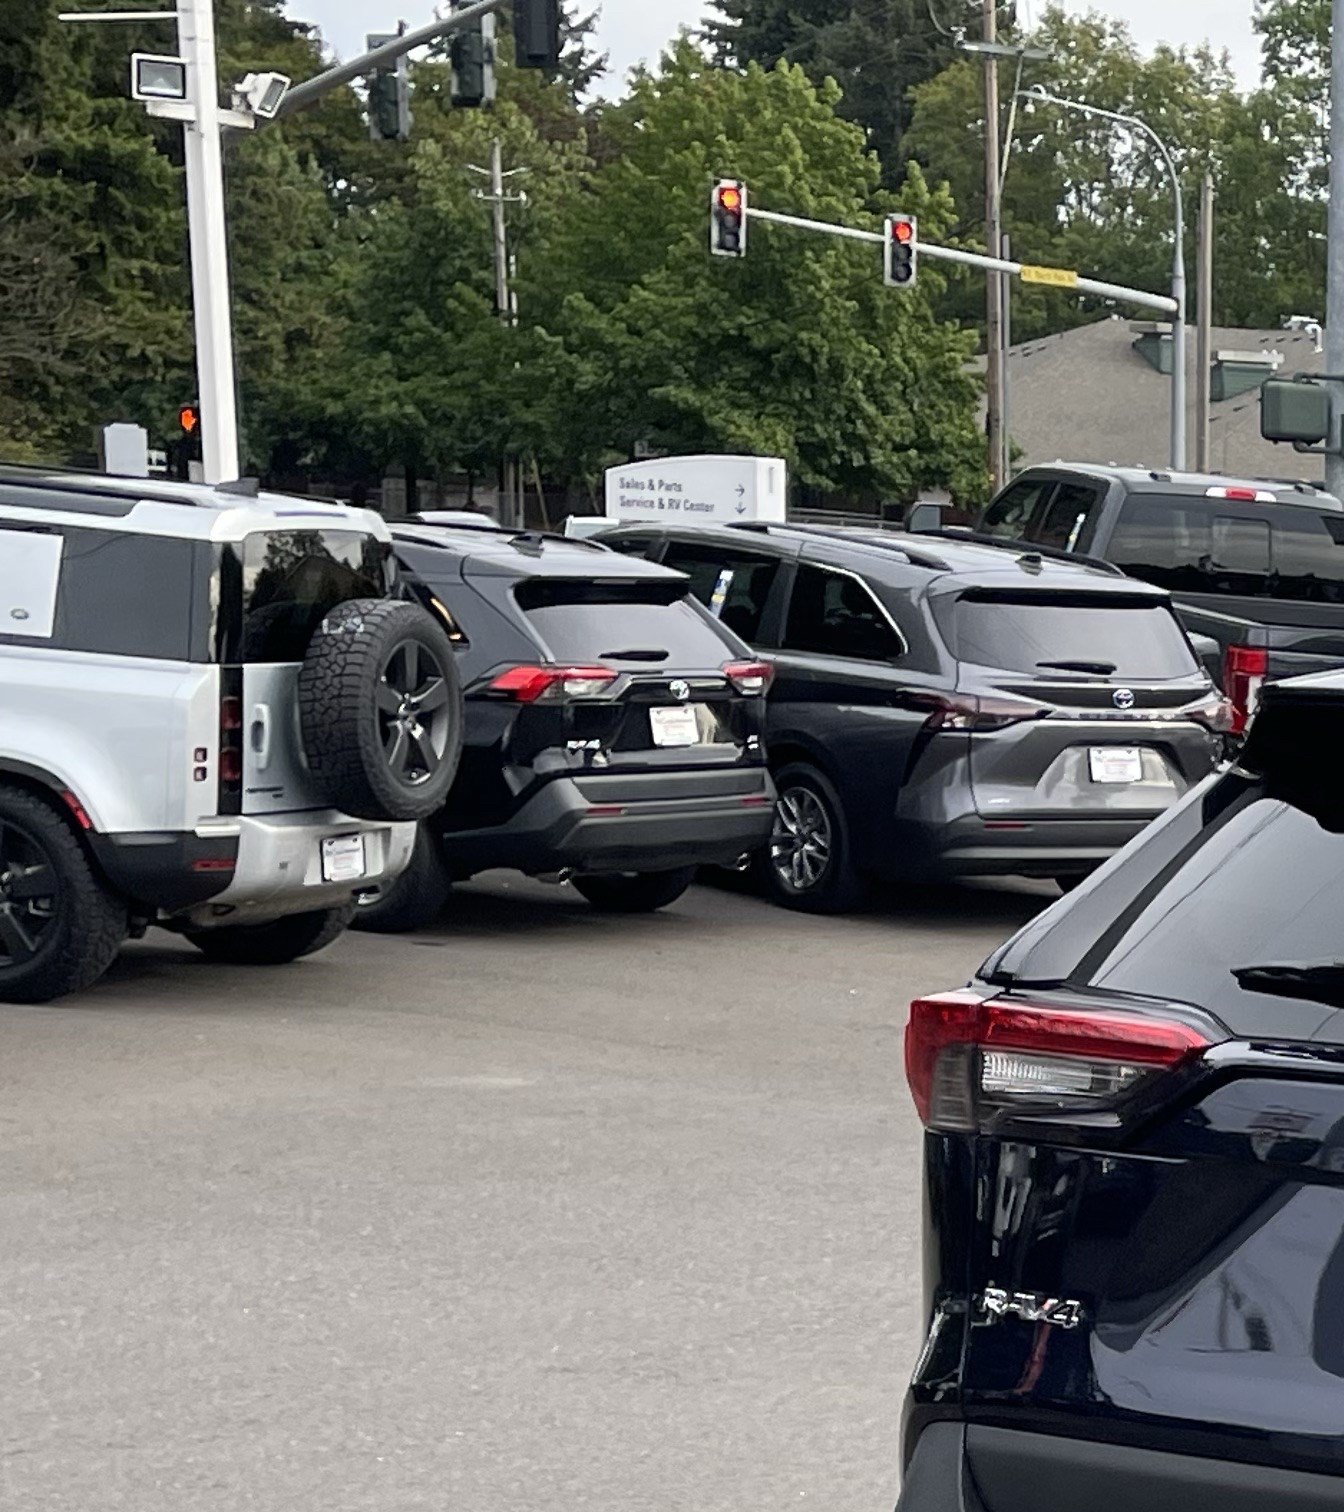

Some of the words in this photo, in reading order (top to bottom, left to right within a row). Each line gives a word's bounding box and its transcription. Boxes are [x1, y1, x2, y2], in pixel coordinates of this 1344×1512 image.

[618, 476, 646, 491] Sales
[647, 478, 656, 492] &
[657, 479, 683, 493] Parts
[619, 495, 656, 508] Service
[657, 497, 666, 510] &
[667, 498, 681, 511] RV
[683, 499, 715, 513] Center
[980, 1287, 1081, 1329] RAV4
